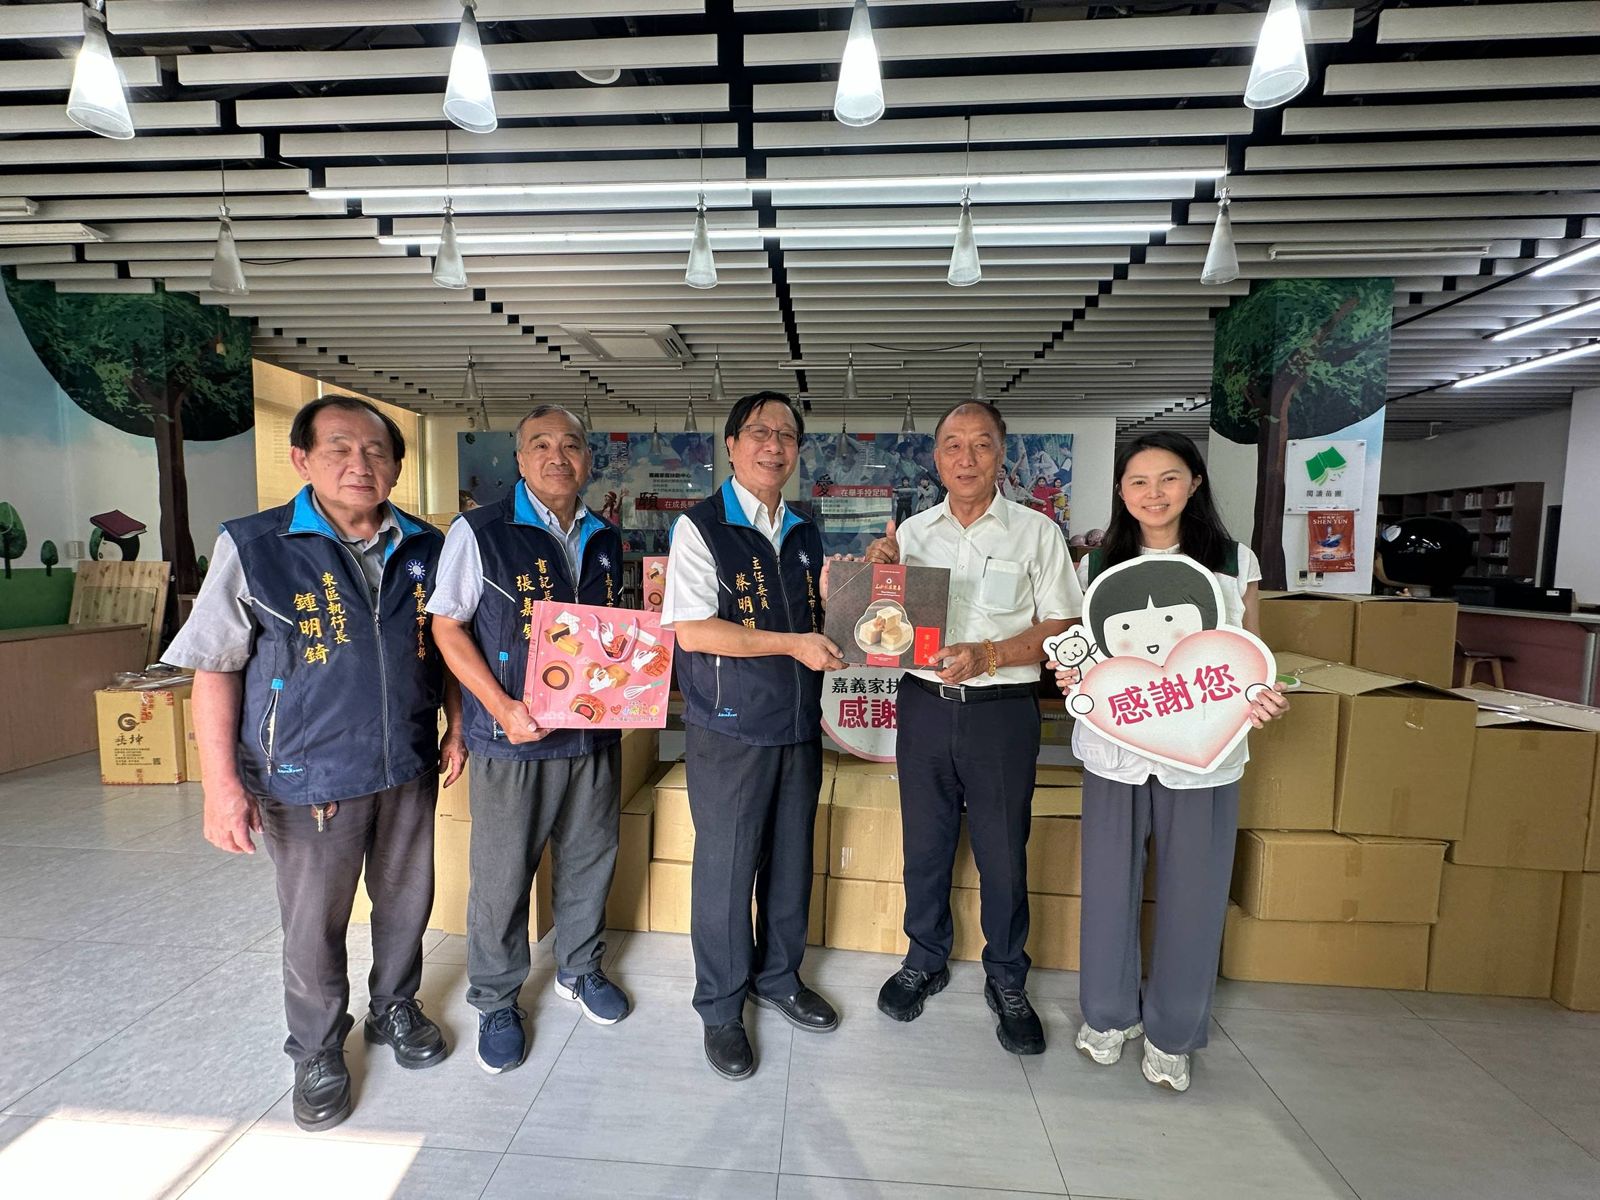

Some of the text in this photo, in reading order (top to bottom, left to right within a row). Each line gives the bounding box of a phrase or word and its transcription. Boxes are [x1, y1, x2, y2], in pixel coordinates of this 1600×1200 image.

[816, 474, 833, 497] 愛
[665, 500, 699, 509] 在成長學
[752, 556, 770, 610] 主任委員
[322, 571, 351, 645] 東區執行長
[831, 677, 900, 694] 嘉義家扶
[1107, 663, 1242, 727] 感謝您
[838, 695, 897, 729] 感謝
